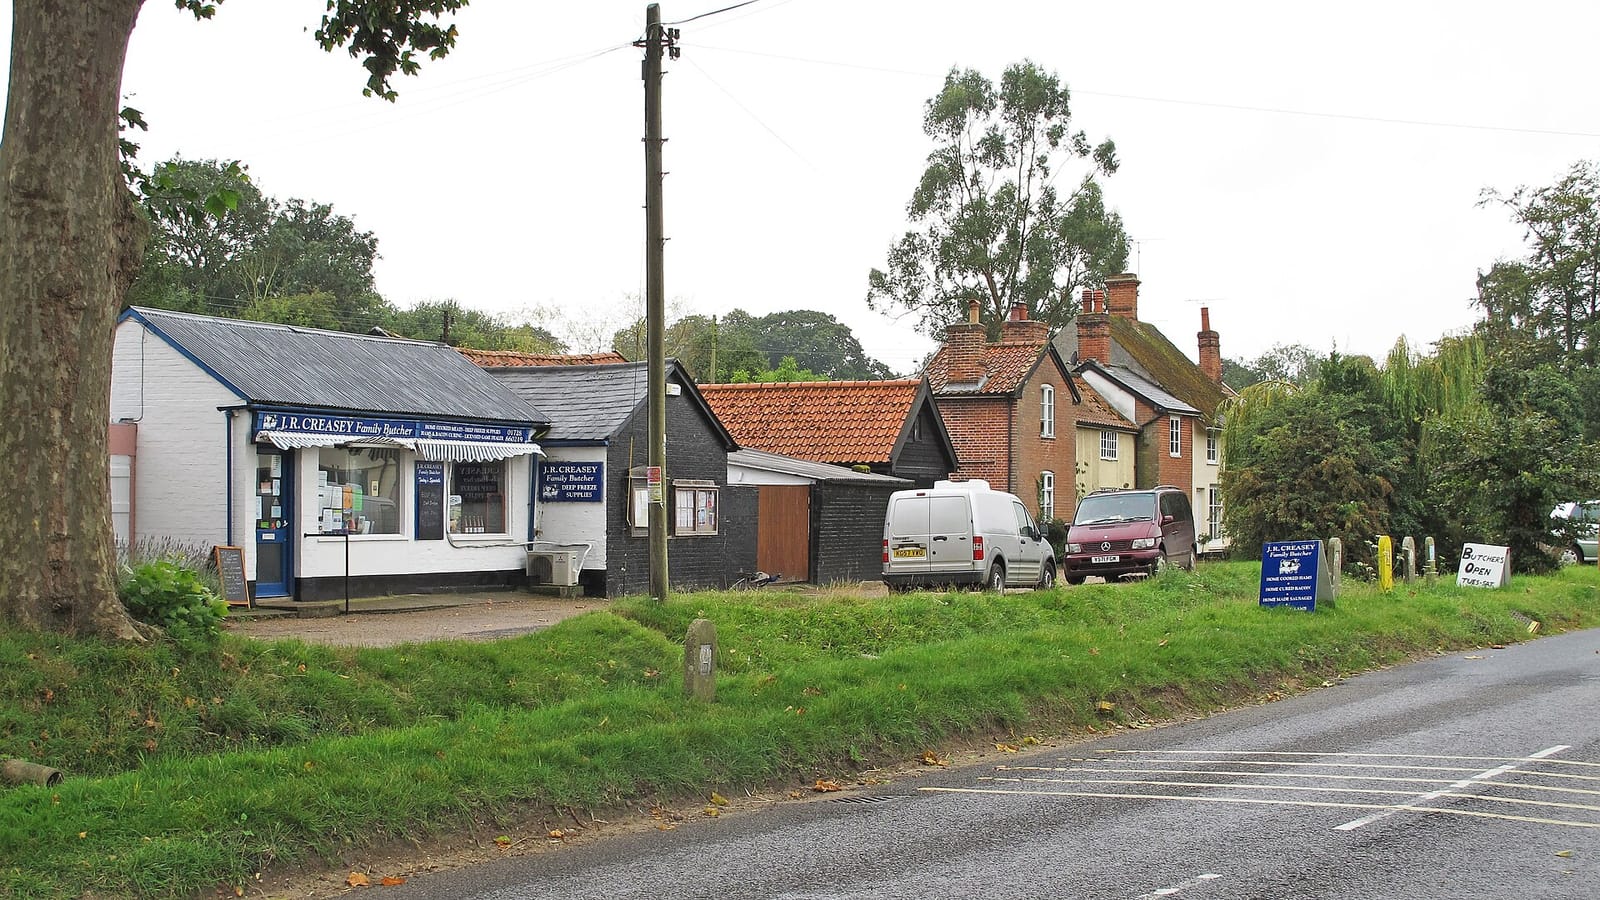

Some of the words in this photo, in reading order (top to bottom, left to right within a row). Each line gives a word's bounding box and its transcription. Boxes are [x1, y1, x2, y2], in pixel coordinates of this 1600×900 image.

[302, 417, 354, 433] CREASEY
[356, 422, 382, 435] Family
[383, 423, 413, 436] Butcher
[558, 466, 598, 474] CREASEY
[569, 474, 594, 482] Butcher
[1462, 547, 1504, 563] BUTCHERS
[1465, 562, 1492, 576] OPEN
